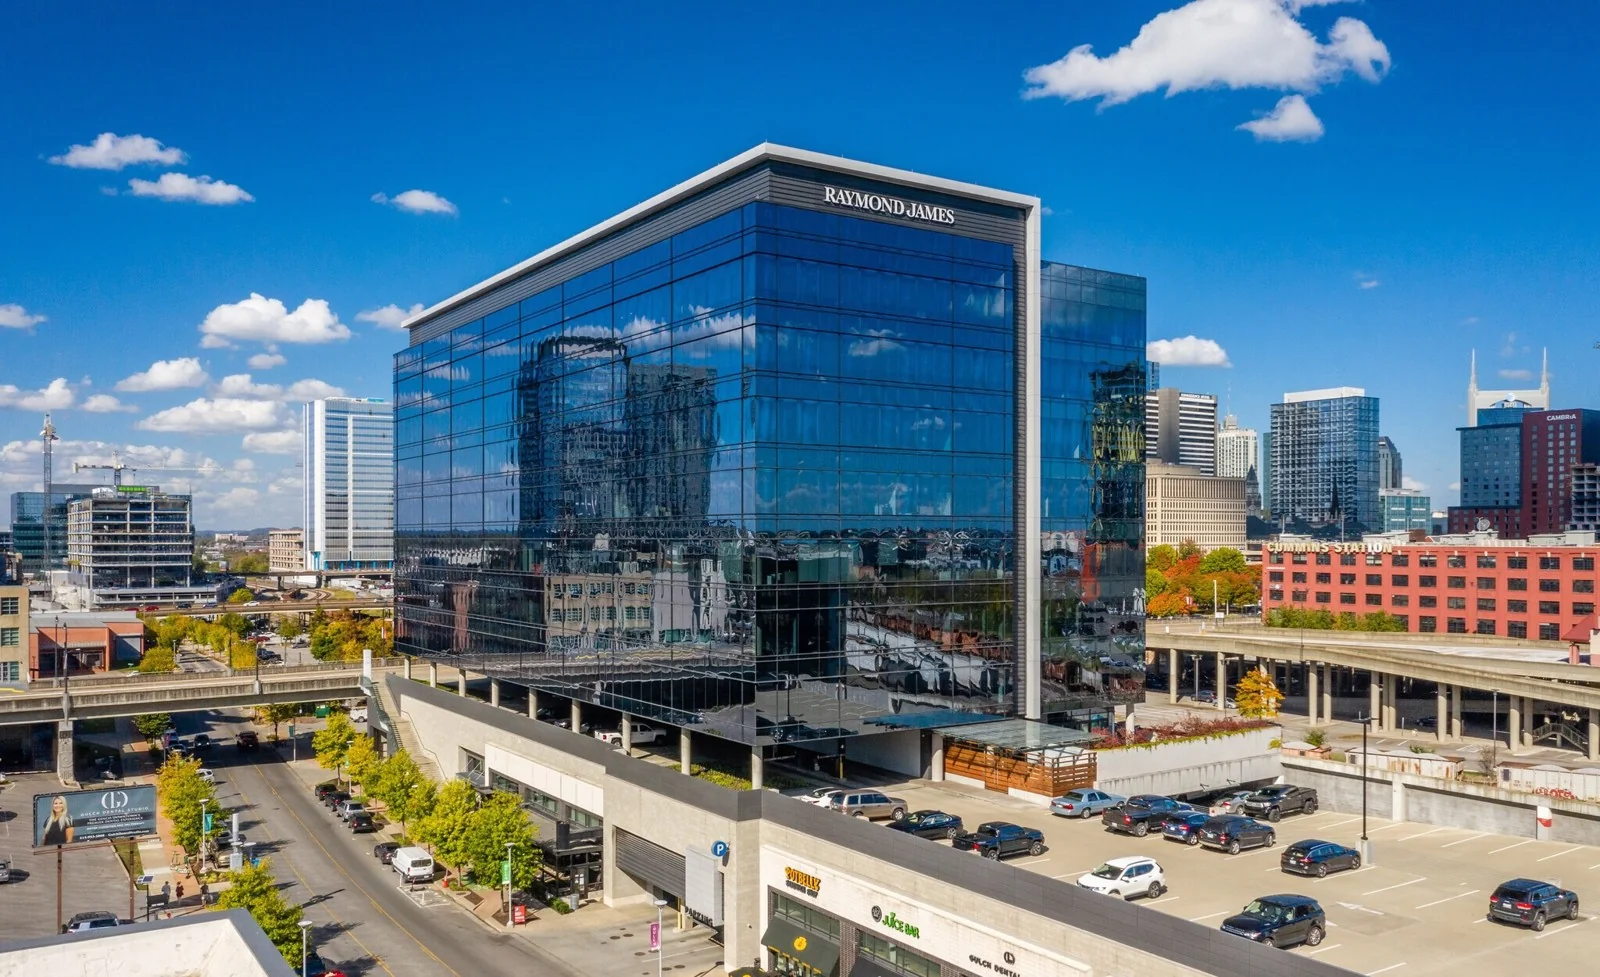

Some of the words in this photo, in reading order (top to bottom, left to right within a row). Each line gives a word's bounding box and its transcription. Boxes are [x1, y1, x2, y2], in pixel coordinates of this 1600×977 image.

[824, 186, 905, 215] RAYMOND
[906, 202, 955, 224] JAMES
[1267, 542, 1330, 554] CUMMINS
[1334, 542, 1392, 554] STATION
[785, 866, 821, 891] POTBELLY
[685, 905, 713, 927] PARKING
[882, 912, 904, 932] JUICE
[905, 923, 920, 939] BAR
[969, 954, 992, 969] GULCH
